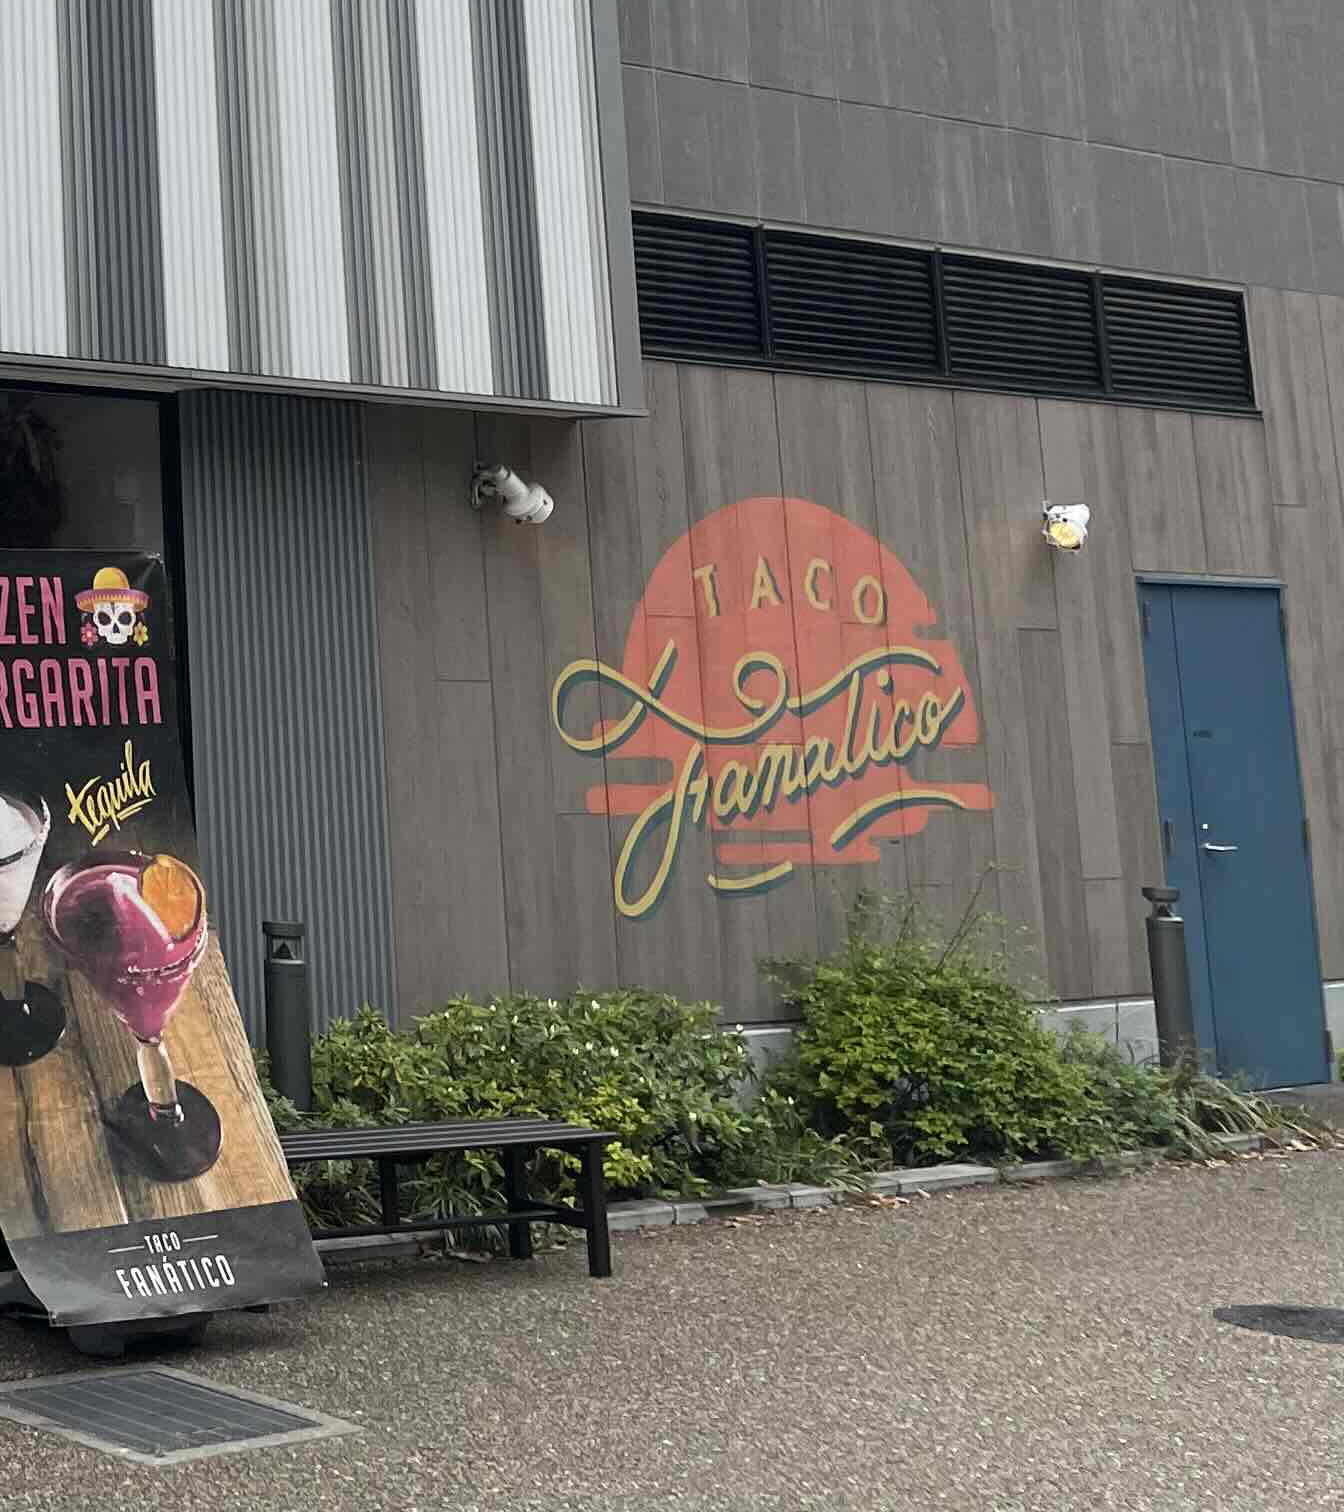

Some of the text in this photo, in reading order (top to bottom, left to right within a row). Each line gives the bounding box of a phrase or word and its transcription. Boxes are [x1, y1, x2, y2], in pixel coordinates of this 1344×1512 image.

[693, 554, 887, 625] TACO
[144, 1231, 181, 1254] TACO
[115, 1255, 235, 1299] FANÁTICO
